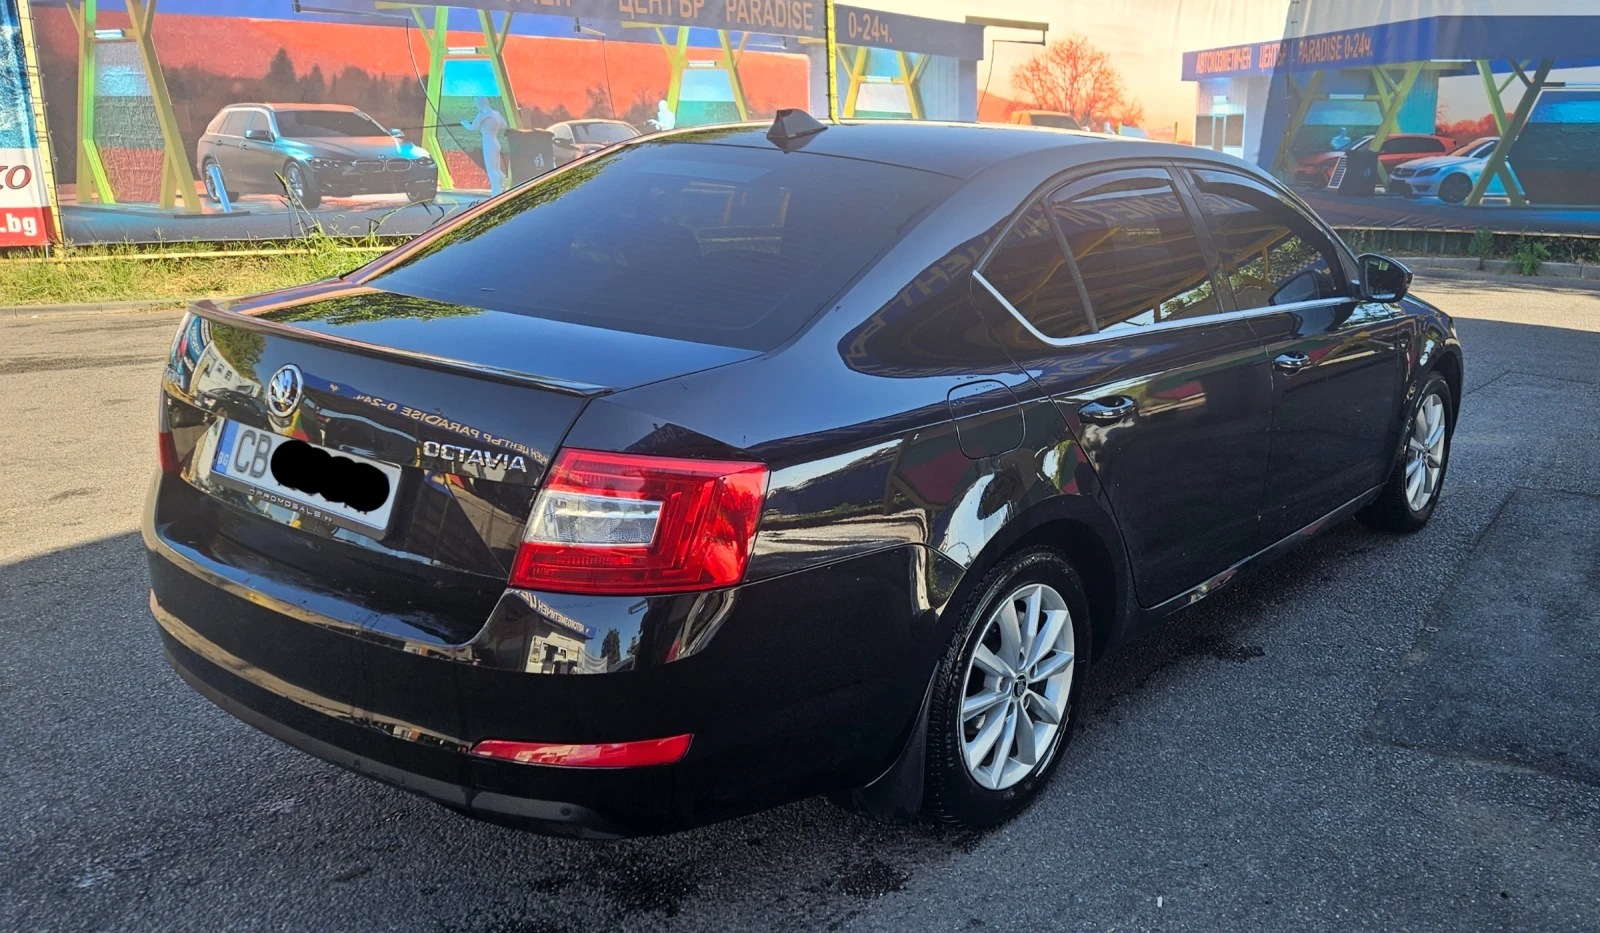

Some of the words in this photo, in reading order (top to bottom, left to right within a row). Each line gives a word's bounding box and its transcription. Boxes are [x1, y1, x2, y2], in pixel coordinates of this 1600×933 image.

[726, 0, 814, 31] PARADISE
[848, 12, 893, 43] 0-24ч.
[1298, 35, 1342, 64] PARADISE
[422, 440, 527, 473] OCTAVIA
